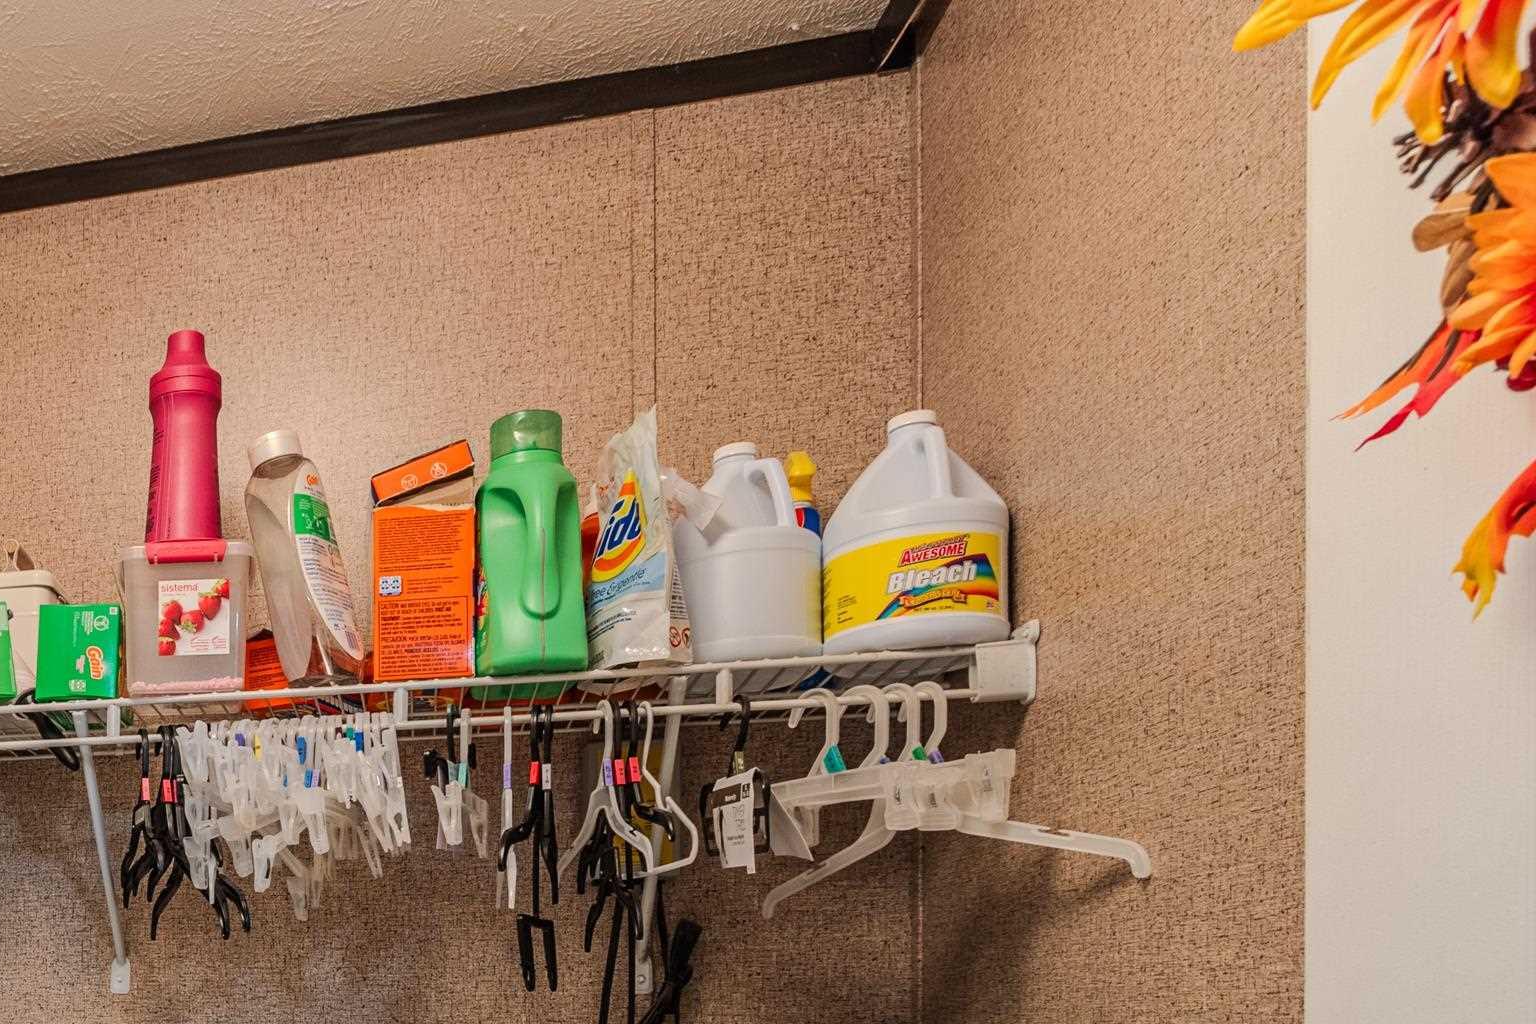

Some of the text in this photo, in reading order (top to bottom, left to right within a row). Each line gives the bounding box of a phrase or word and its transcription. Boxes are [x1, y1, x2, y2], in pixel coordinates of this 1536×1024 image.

[898, 541, 967, 567] AWESOME
[886, 559, 978, 595] Bleach
[86, 646, 104, 679] Gain
